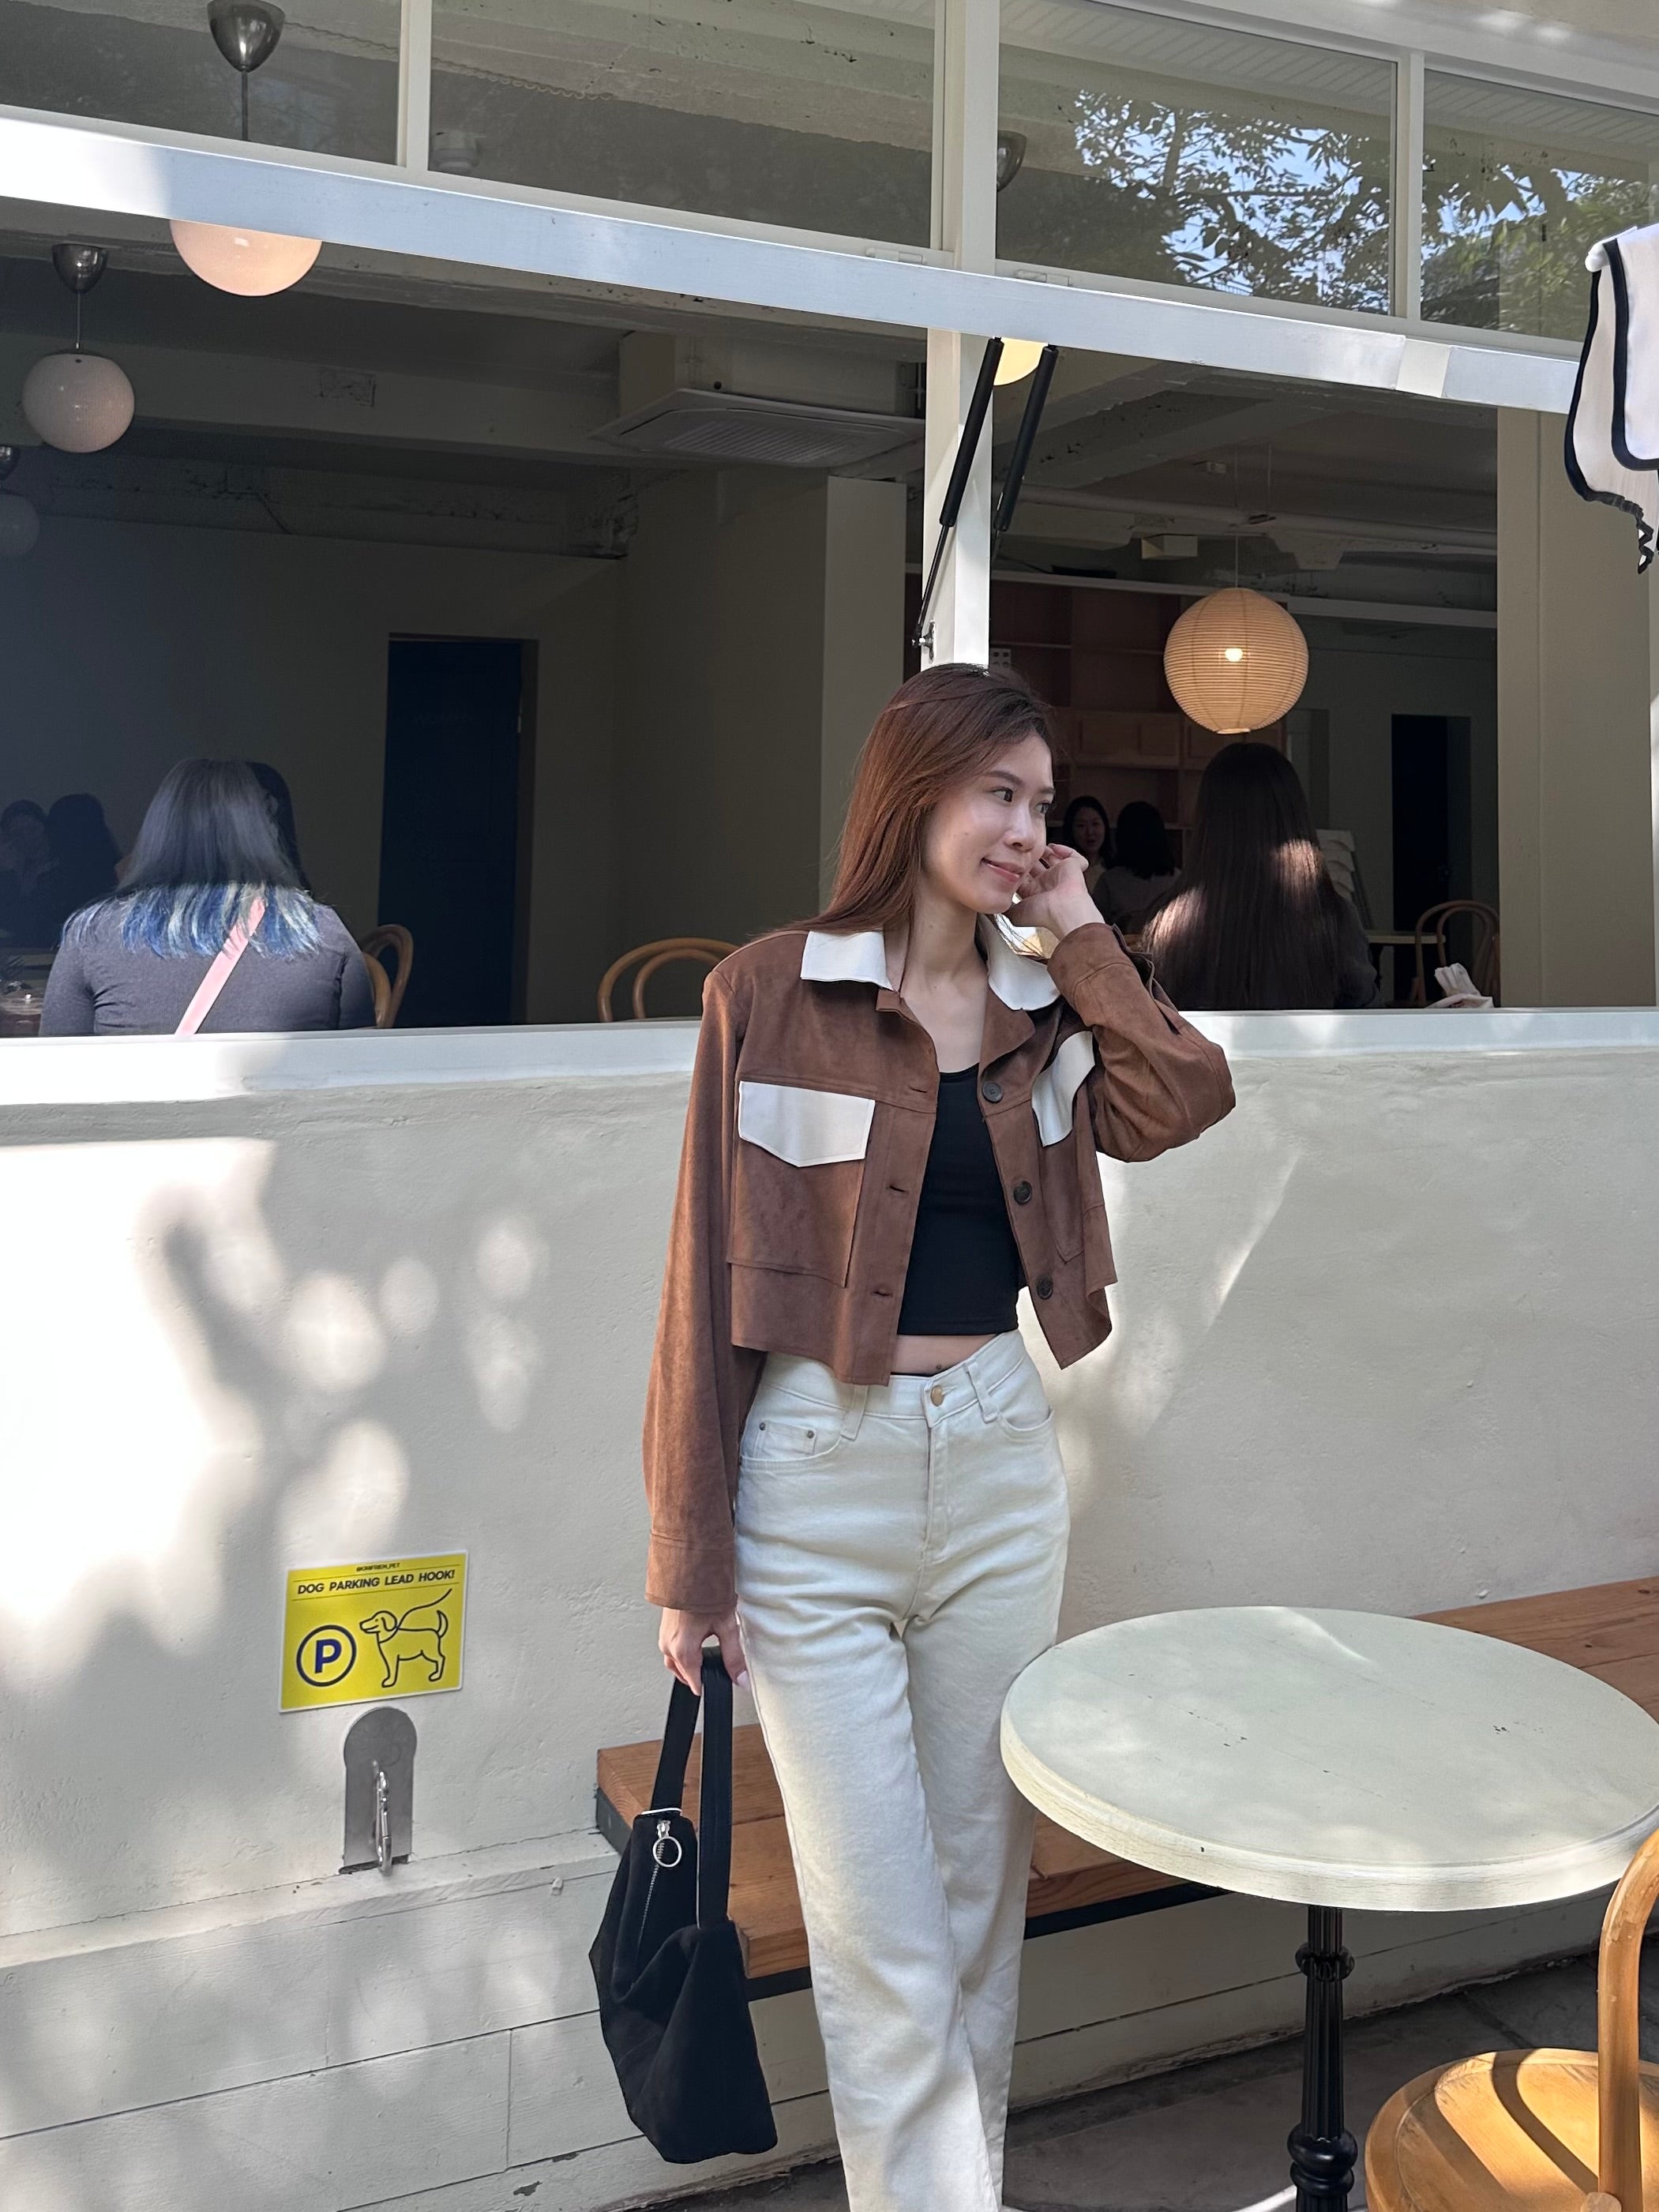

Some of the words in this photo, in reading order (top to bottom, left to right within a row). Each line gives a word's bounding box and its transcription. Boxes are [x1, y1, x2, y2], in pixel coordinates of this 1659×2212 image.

[298, 1583, 325, 1594] DOG
[328, 1577, 381, 1591] PARKING
[385, 1574, 414, 1586] LEAD
[419, 1569, 456, 1582] HOOK!
[314, 1639, 342, 1673] P
